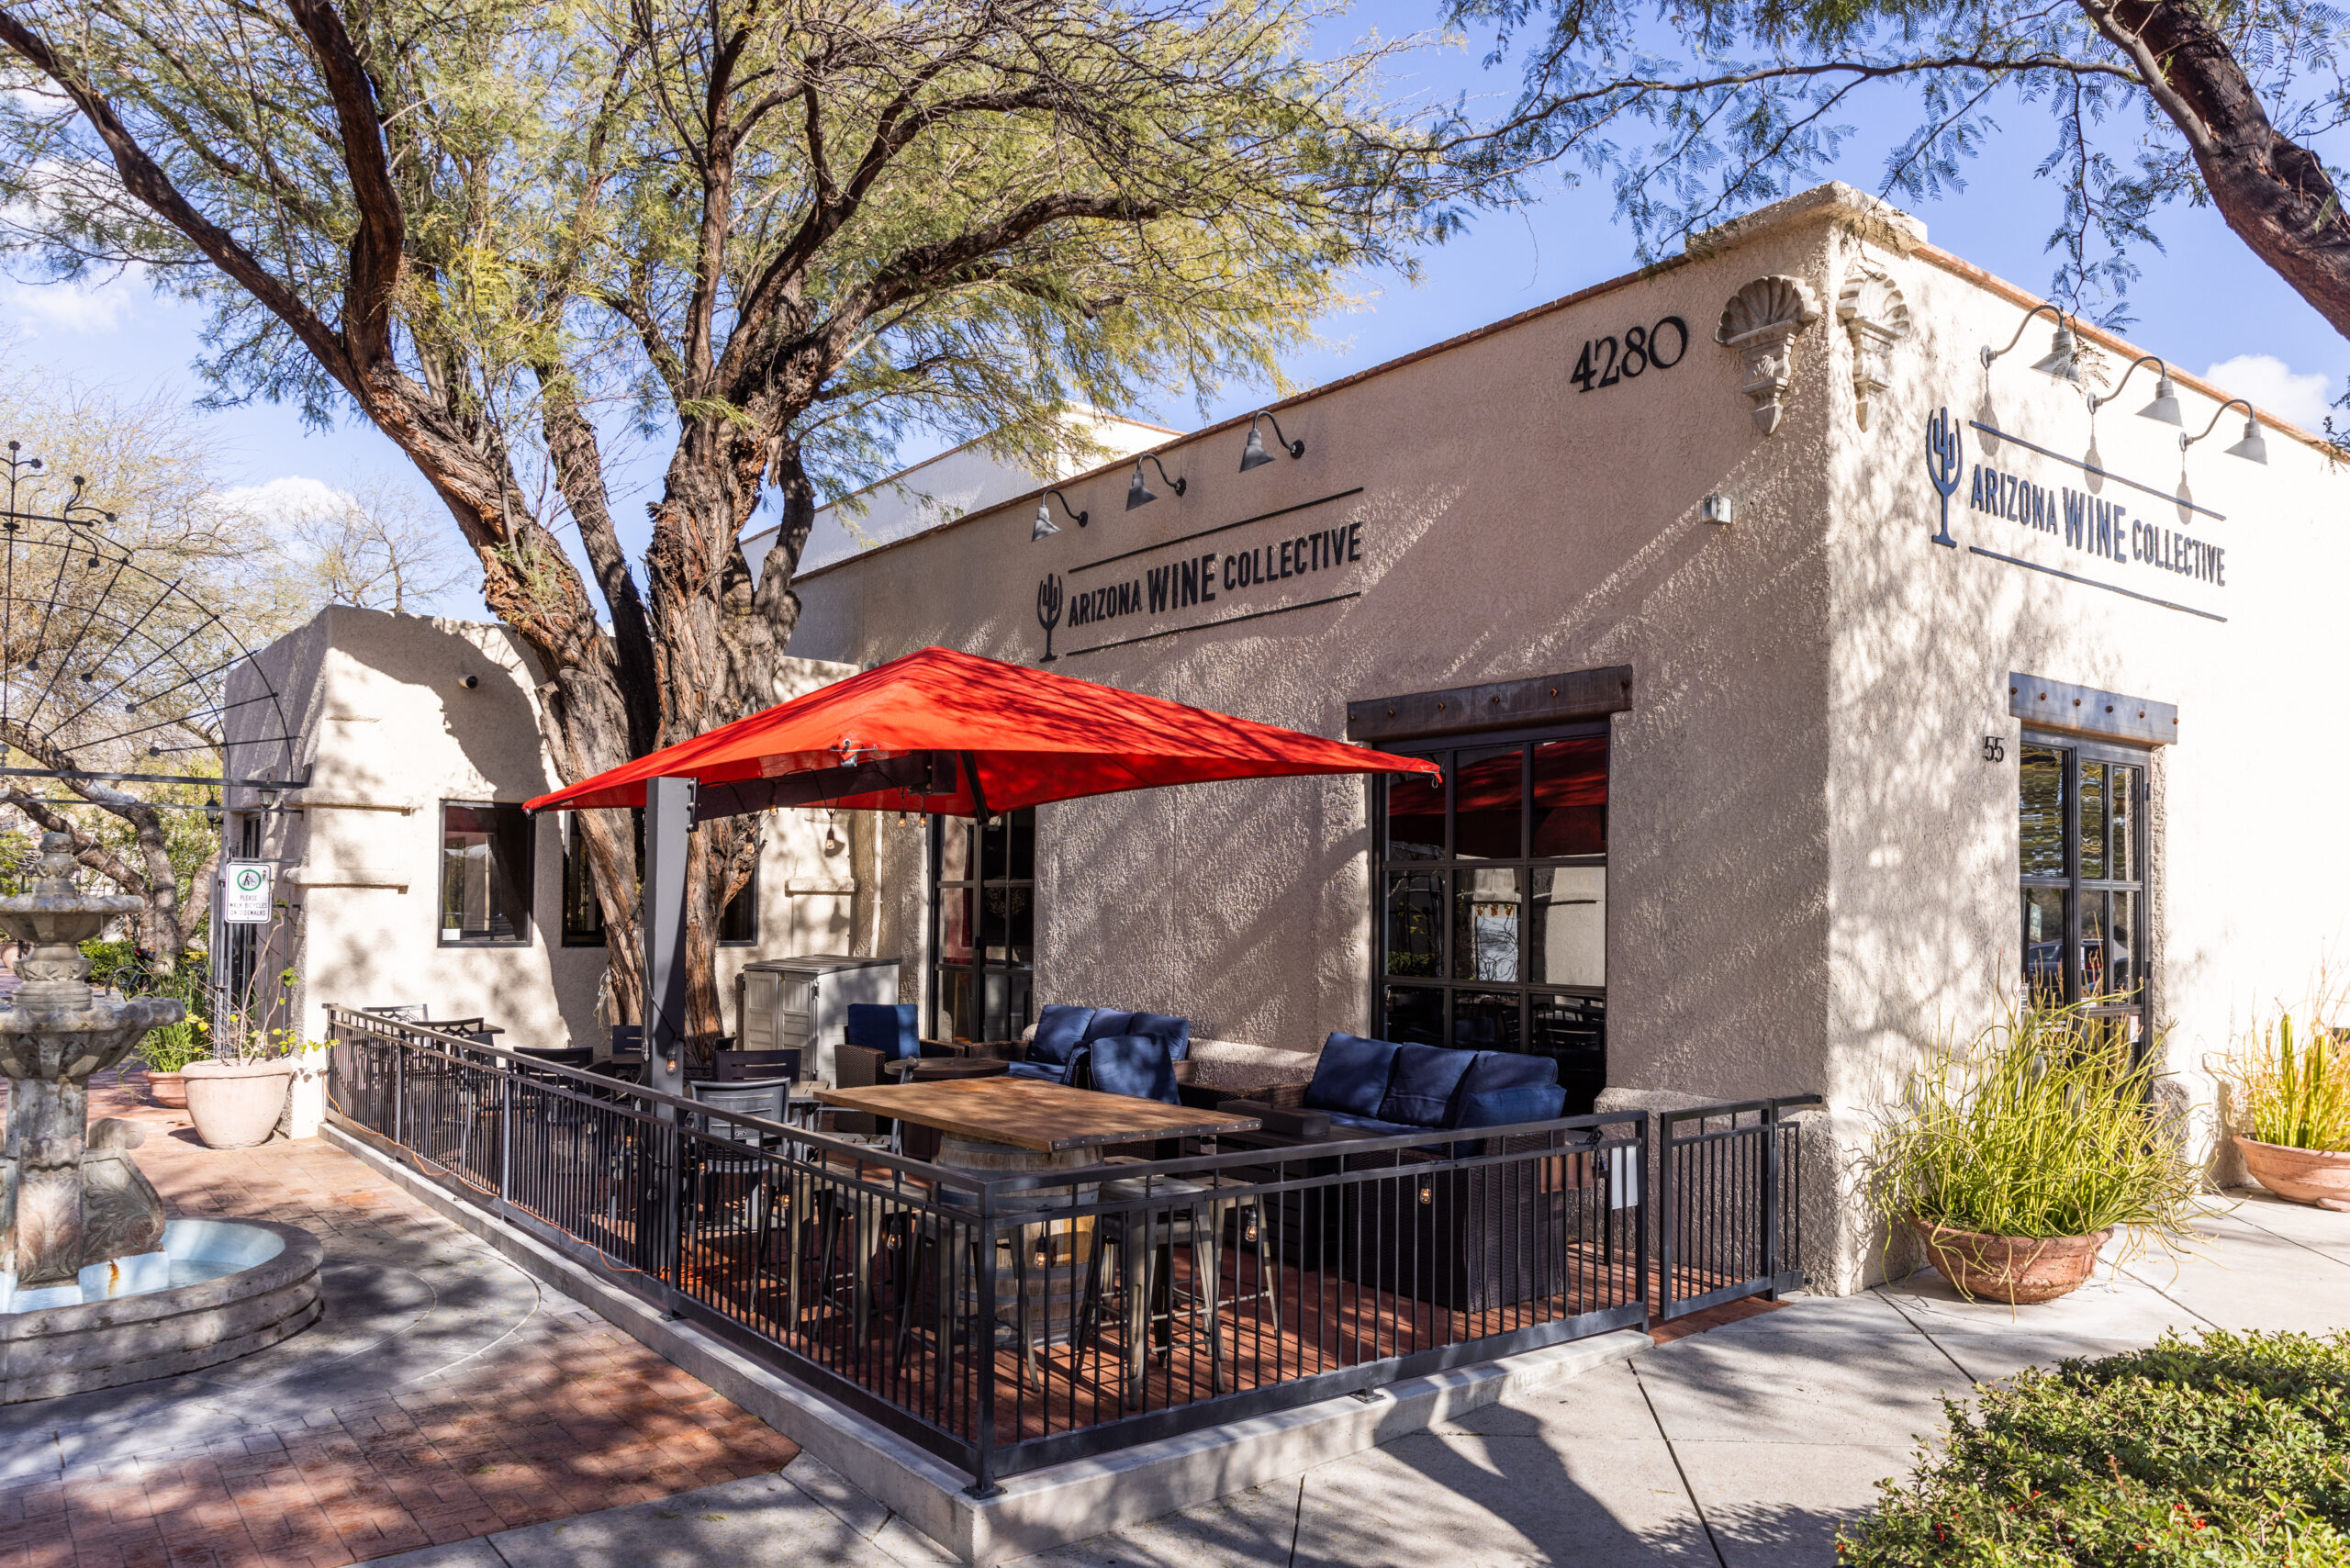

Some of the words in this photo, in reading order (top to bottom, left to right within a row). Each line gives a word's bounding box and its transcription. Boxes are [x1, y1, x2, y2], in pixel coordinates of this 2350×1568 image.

[1570, 316, 1688, 393] 4280
[1970, 464, 2058, 535] ARIZONA
[2063, 487, 2127, 564] WINE
[2132, 520, 2226, 586] COLLECTIVE
[1069, 579, 1142, 627] ARIZONA
[1147, 553, 1216, 614] WINE
[1224, 521, 1362, 590] COLLECTIVE
[1983, 736, 2005, 762] 55
